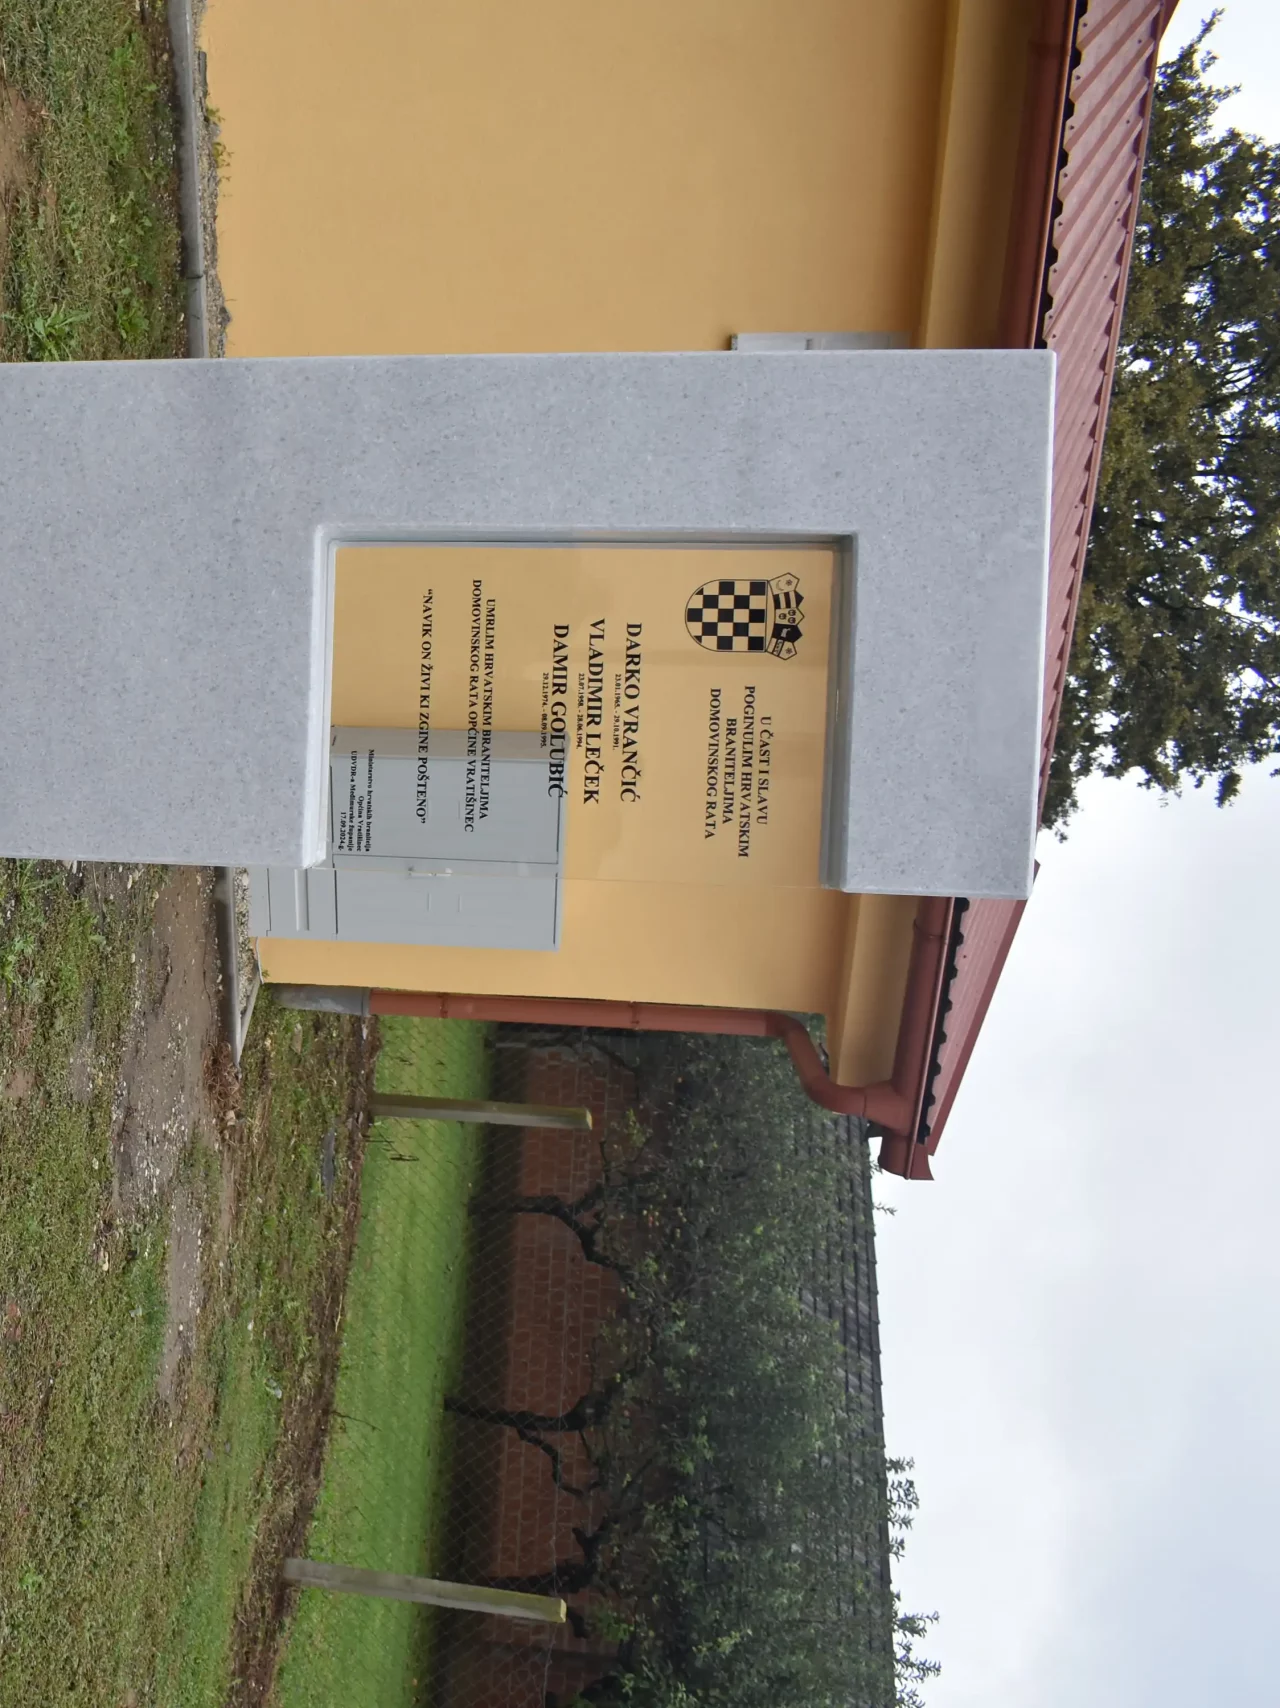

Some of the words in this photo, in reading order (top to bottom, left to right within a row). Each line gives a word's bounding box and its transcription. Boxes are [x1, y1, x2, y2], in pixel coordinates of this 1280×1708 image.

[421, 641, 432, 660] ON
[470, 579, 482, 672] DOMOVINSKOG
[485, 599, 495, 650] UMRLIM
[551, 624, 569, 696] DAMIR
[420, 663, 432, 690] ŽIVI
[468, 675, 479, 708] RATA
[482, 653, 493, 726] HRVATSKIM
[586, 618, 605, 727] VLADIMIR
[624, 623, 642, 699] DARKO
[418, 712, 429, 753] ZGINE
[419, 694, 429, 709] KI
[467, 711, 479, 756] OPĆINE
[741, 685, 755, 768] POGINULIM
[760, 716, 771, 725] U
[479, 730, 491, 819] BRANITELJIMA
[548, 701, 568, 798] GOLUBIĆ
[583, 732, 604, 804] LEČEK
[620, 705, 641, 803] VRANČIĆ
[706, 688, 721, 797] DOMOVINSKOG
[722, 718, 736, 824] BRANITELJIMA
[758, 729, 774, 766] ČAST
[464, 760, 476, 832] VRATIŠINEC
[705, 801, 717, 839] RATA
[738, 772, 752, 858] HRVATSKIM
[756, 778, 769, 825] SLAVU
[347, 825, 355, 851] županije
